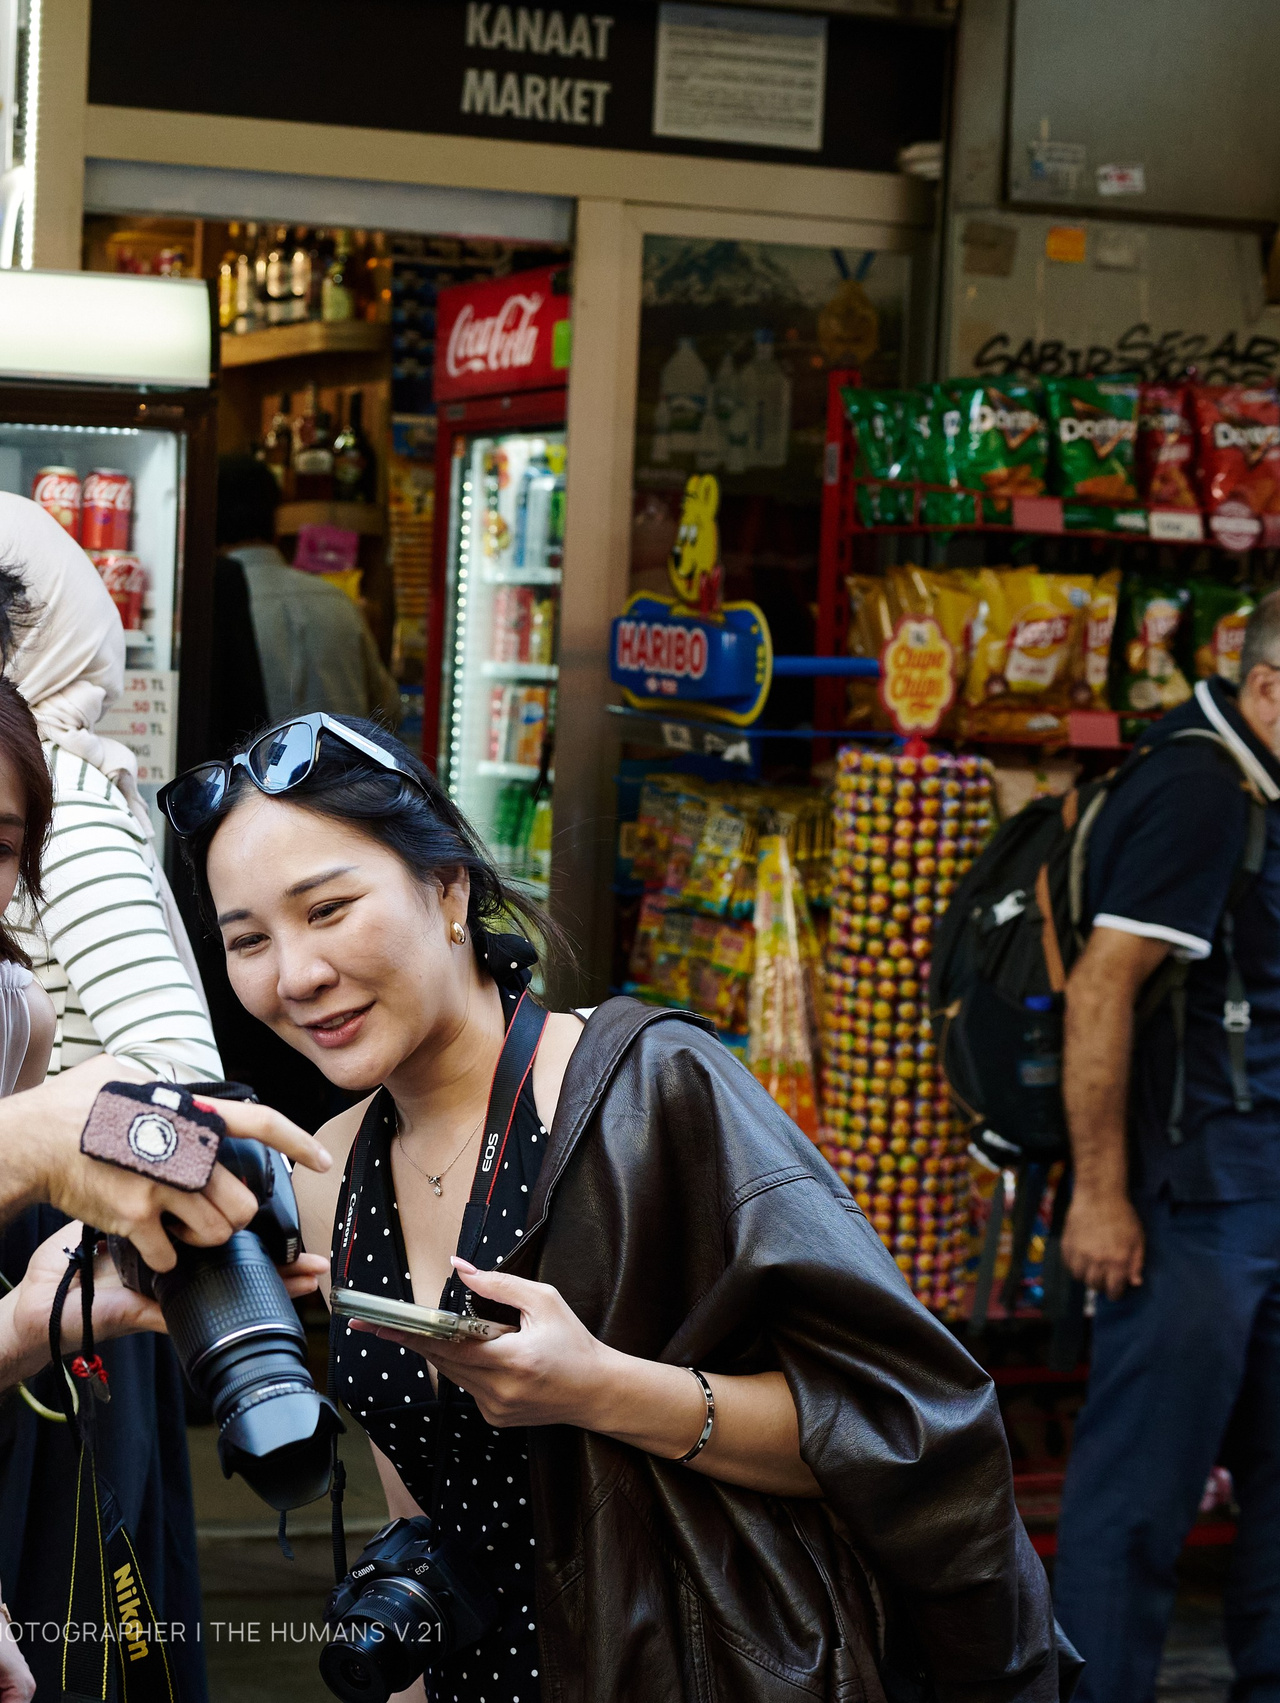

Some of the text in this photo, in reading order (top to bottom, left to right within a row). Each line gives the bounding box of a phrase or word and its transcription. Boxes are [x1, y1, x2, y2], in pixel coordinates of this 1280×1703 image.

[465, 2, 614, 61] KANAAT
[461, 68, 611, 128] MARKET
[616, 621, 708, 680] HARIBO
[480, 1132, 500, 1173] EOS
[341, 1192, 359, 1248] Canon
[286, 1237, 298, 1264] Nikon
[351, 1563, 376, 1580] Canon
[414, 1562, 430, 1577] EOS
[113, 1561, 151, 1663] Nikon
